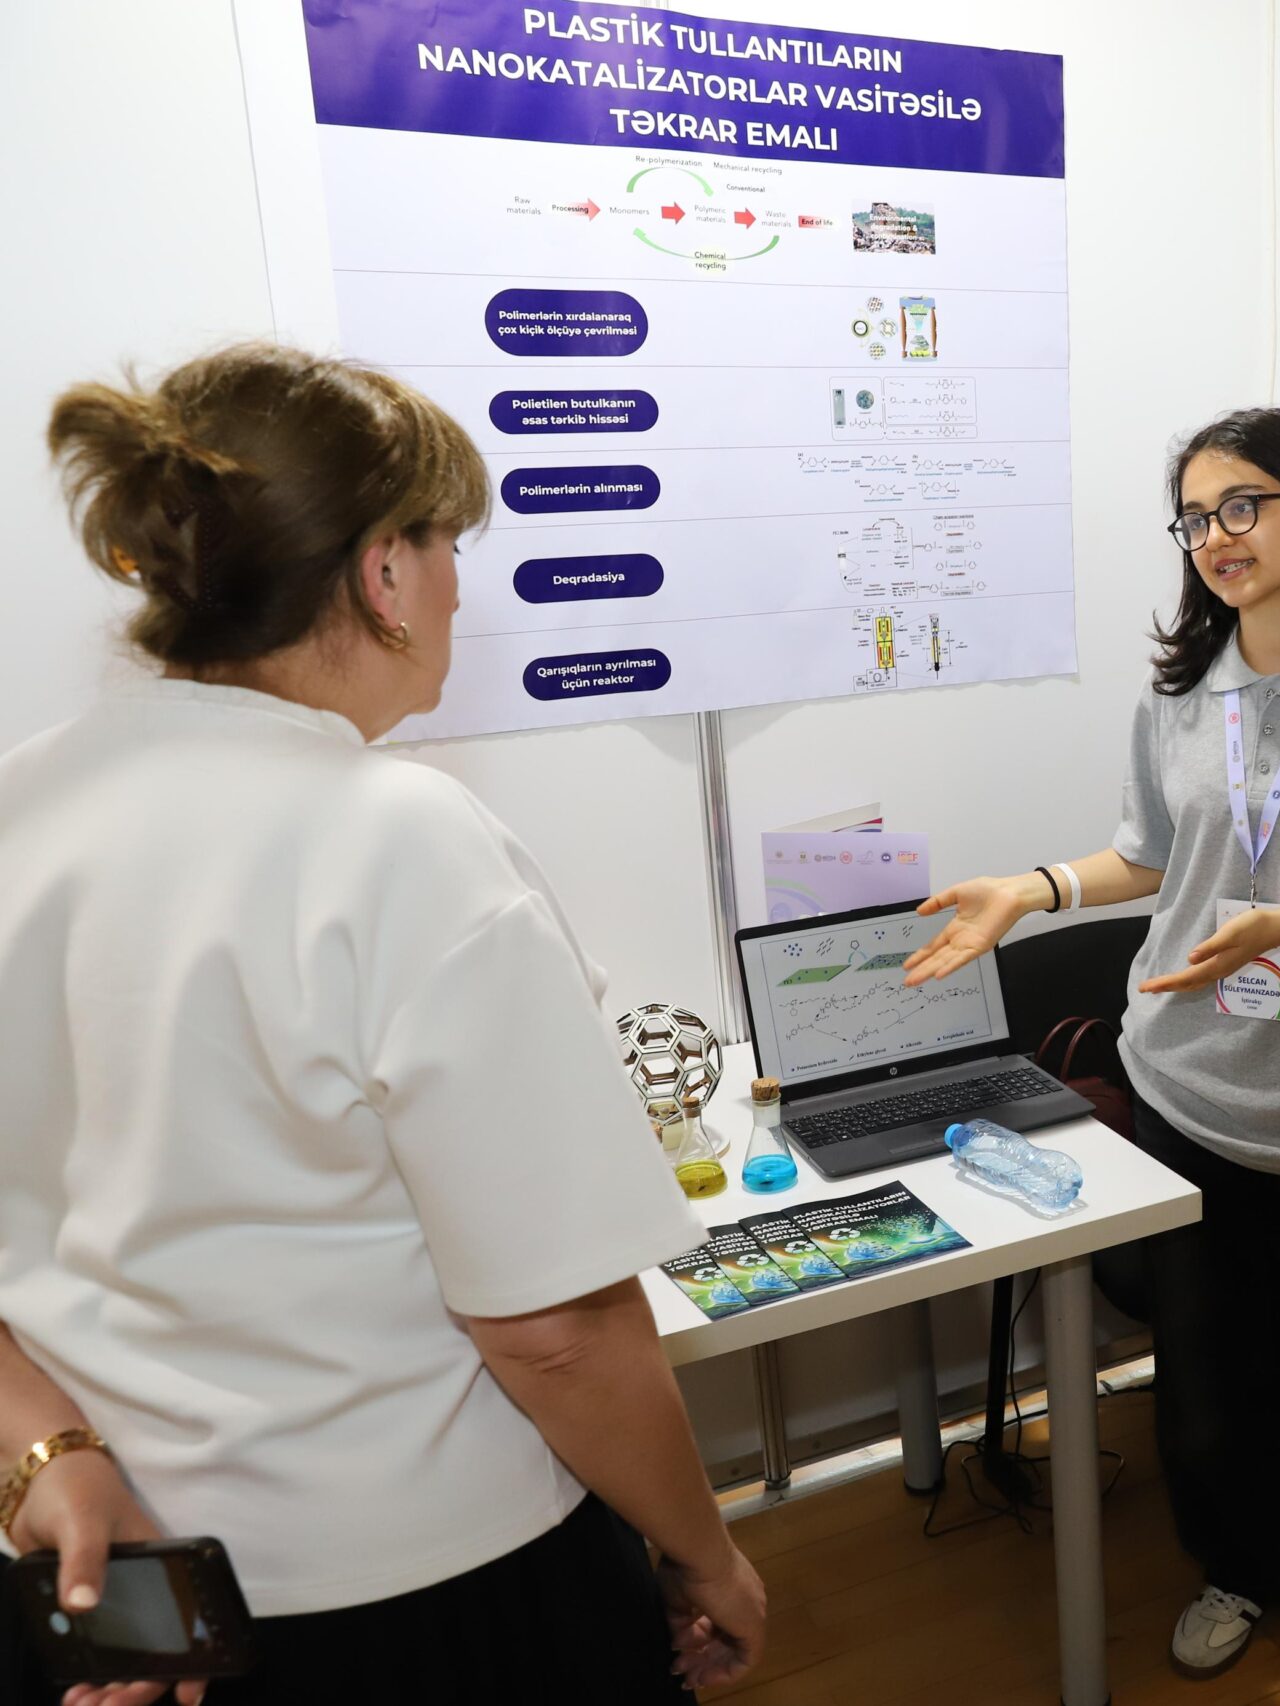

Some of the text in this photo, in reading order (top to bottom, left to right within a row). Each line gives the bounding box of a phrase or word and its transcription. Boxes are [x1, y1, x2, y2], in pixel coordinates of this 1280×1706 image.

[523, 8, 903, 74] PLASTİK TULLANTILARIN
[417, 43, 982, 121] NANOKATALİZATORLAR VASİTƏSİLƏ
[610, 108, 838, 152] TƏKRAR EMALI
[636, 155, 702, 167] Re-polymerization
[713, 162, 782, 175] Mechanical recycling
[727, 184, 765, 192] Conventional
[515, 196, 530, 204] Raw
[507, 206, 541, 215] materials
[552, 204, 589, 214] Processing
[610, 206, 649, 215] Monomers
[694, 205, 726, 214] Polymeric
[766, 210, 786, 218] Waste
[696, 214, 726, 223] materials
[761, 219, 791, 228] materials
[694, 251, 726, 260] Chemical
[695, 261, 726, 271] recycling
[499, 311, 631, 323] Polimerlərin xırdalanaraq
[498, 325, 637, 337] çox kiçik ölçüyə çevrilməsi
[512, 398, 636, 409] Polietilen butulkanın
[522, 413, 629, 425] əsas tərkib hissəsi
[519, 482, 643, 496] Polimerlərin alınması
[553, 572, 625, 585] Deqradasiya
[537, 659, 657, 677] Qarışıqların ayrılması
[561, 674, 634, 690] üçün reaktor
[1238, 976, 1267, 986] SELCAN
[1224, 985, 1280, 997] SÜLEYMANZADƏ
[710, 1231, 746, 1242] LASTİK
[709, 1239, 757, 1252] VASİTƏS
[664, 1253, 710, 1268] VASİTƏS
